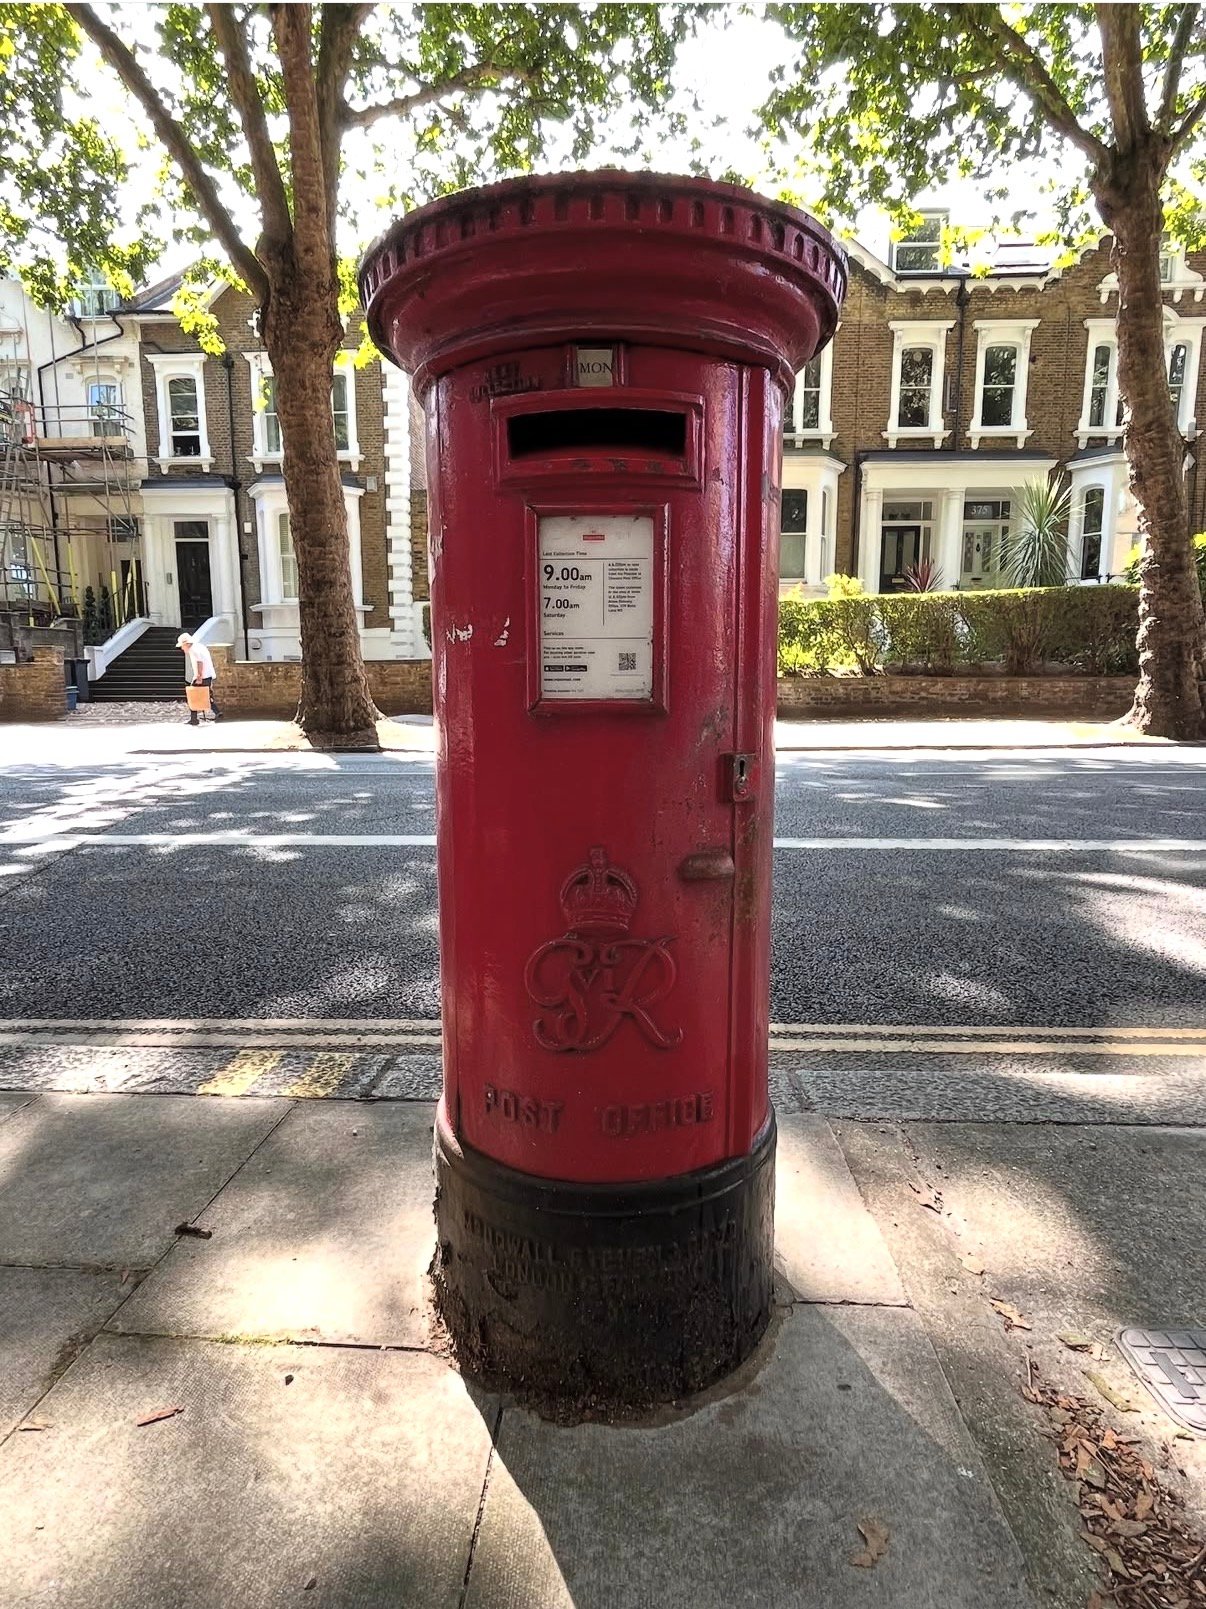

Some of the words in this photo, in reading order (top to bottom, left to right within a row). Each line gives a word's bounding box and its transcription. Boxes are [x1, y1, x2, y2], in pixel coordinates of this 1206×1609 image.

[579, 362, 613, 374] MON
[543, 564, 592, 582] 9.00am
[543, 597, 580, 609] 7.00am
[483, 1082, 565, 1135] POST
[602, 1089, 715, 1136] OFFICE
